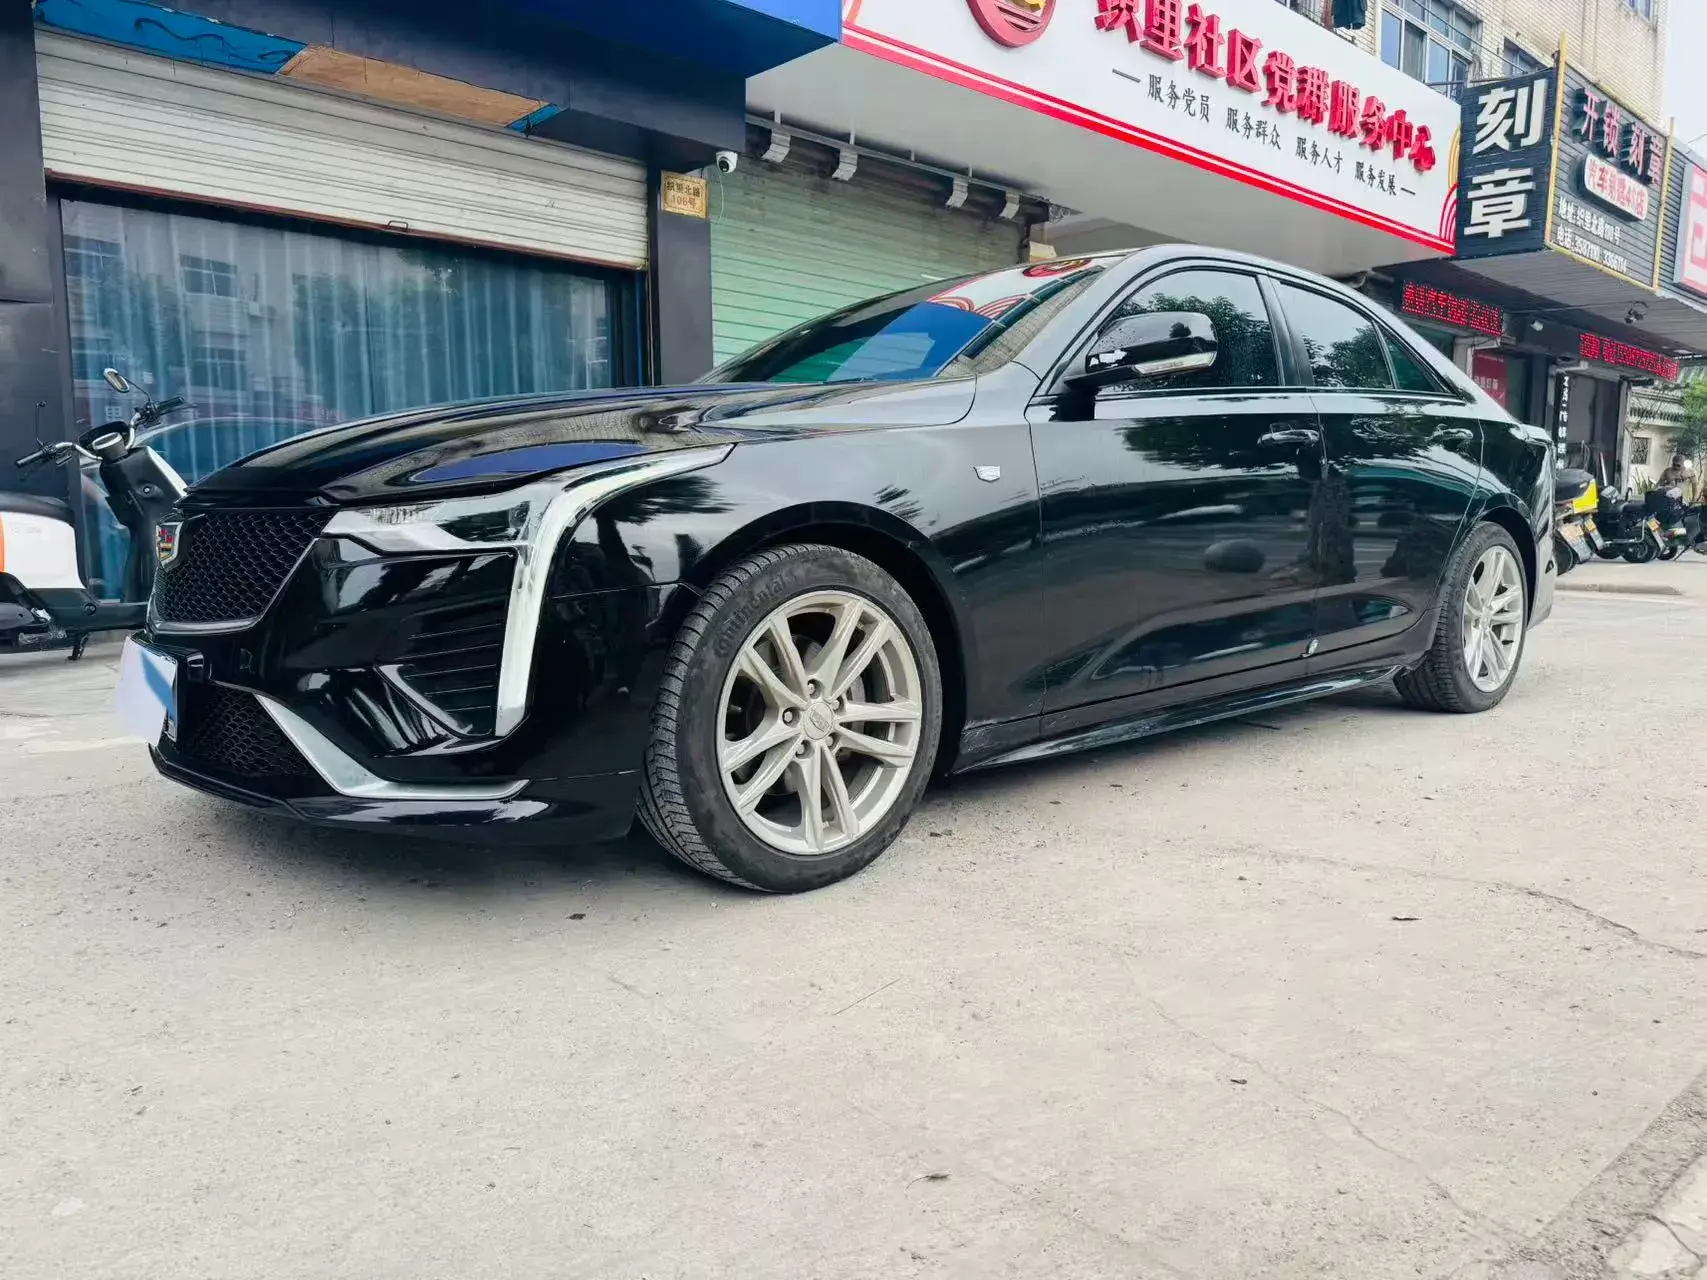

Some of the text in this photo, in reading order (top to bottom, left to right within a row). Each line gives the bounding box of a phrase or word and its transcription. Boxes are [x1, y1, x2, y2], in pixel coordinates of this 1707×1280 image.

[1148, 74, 1397, 196] 服务党员 服务群众 服务人才 服务发展
[1464, 78, 1549, 238] 刻章
[1581, 86, 1663, 187] 开锁刻章
